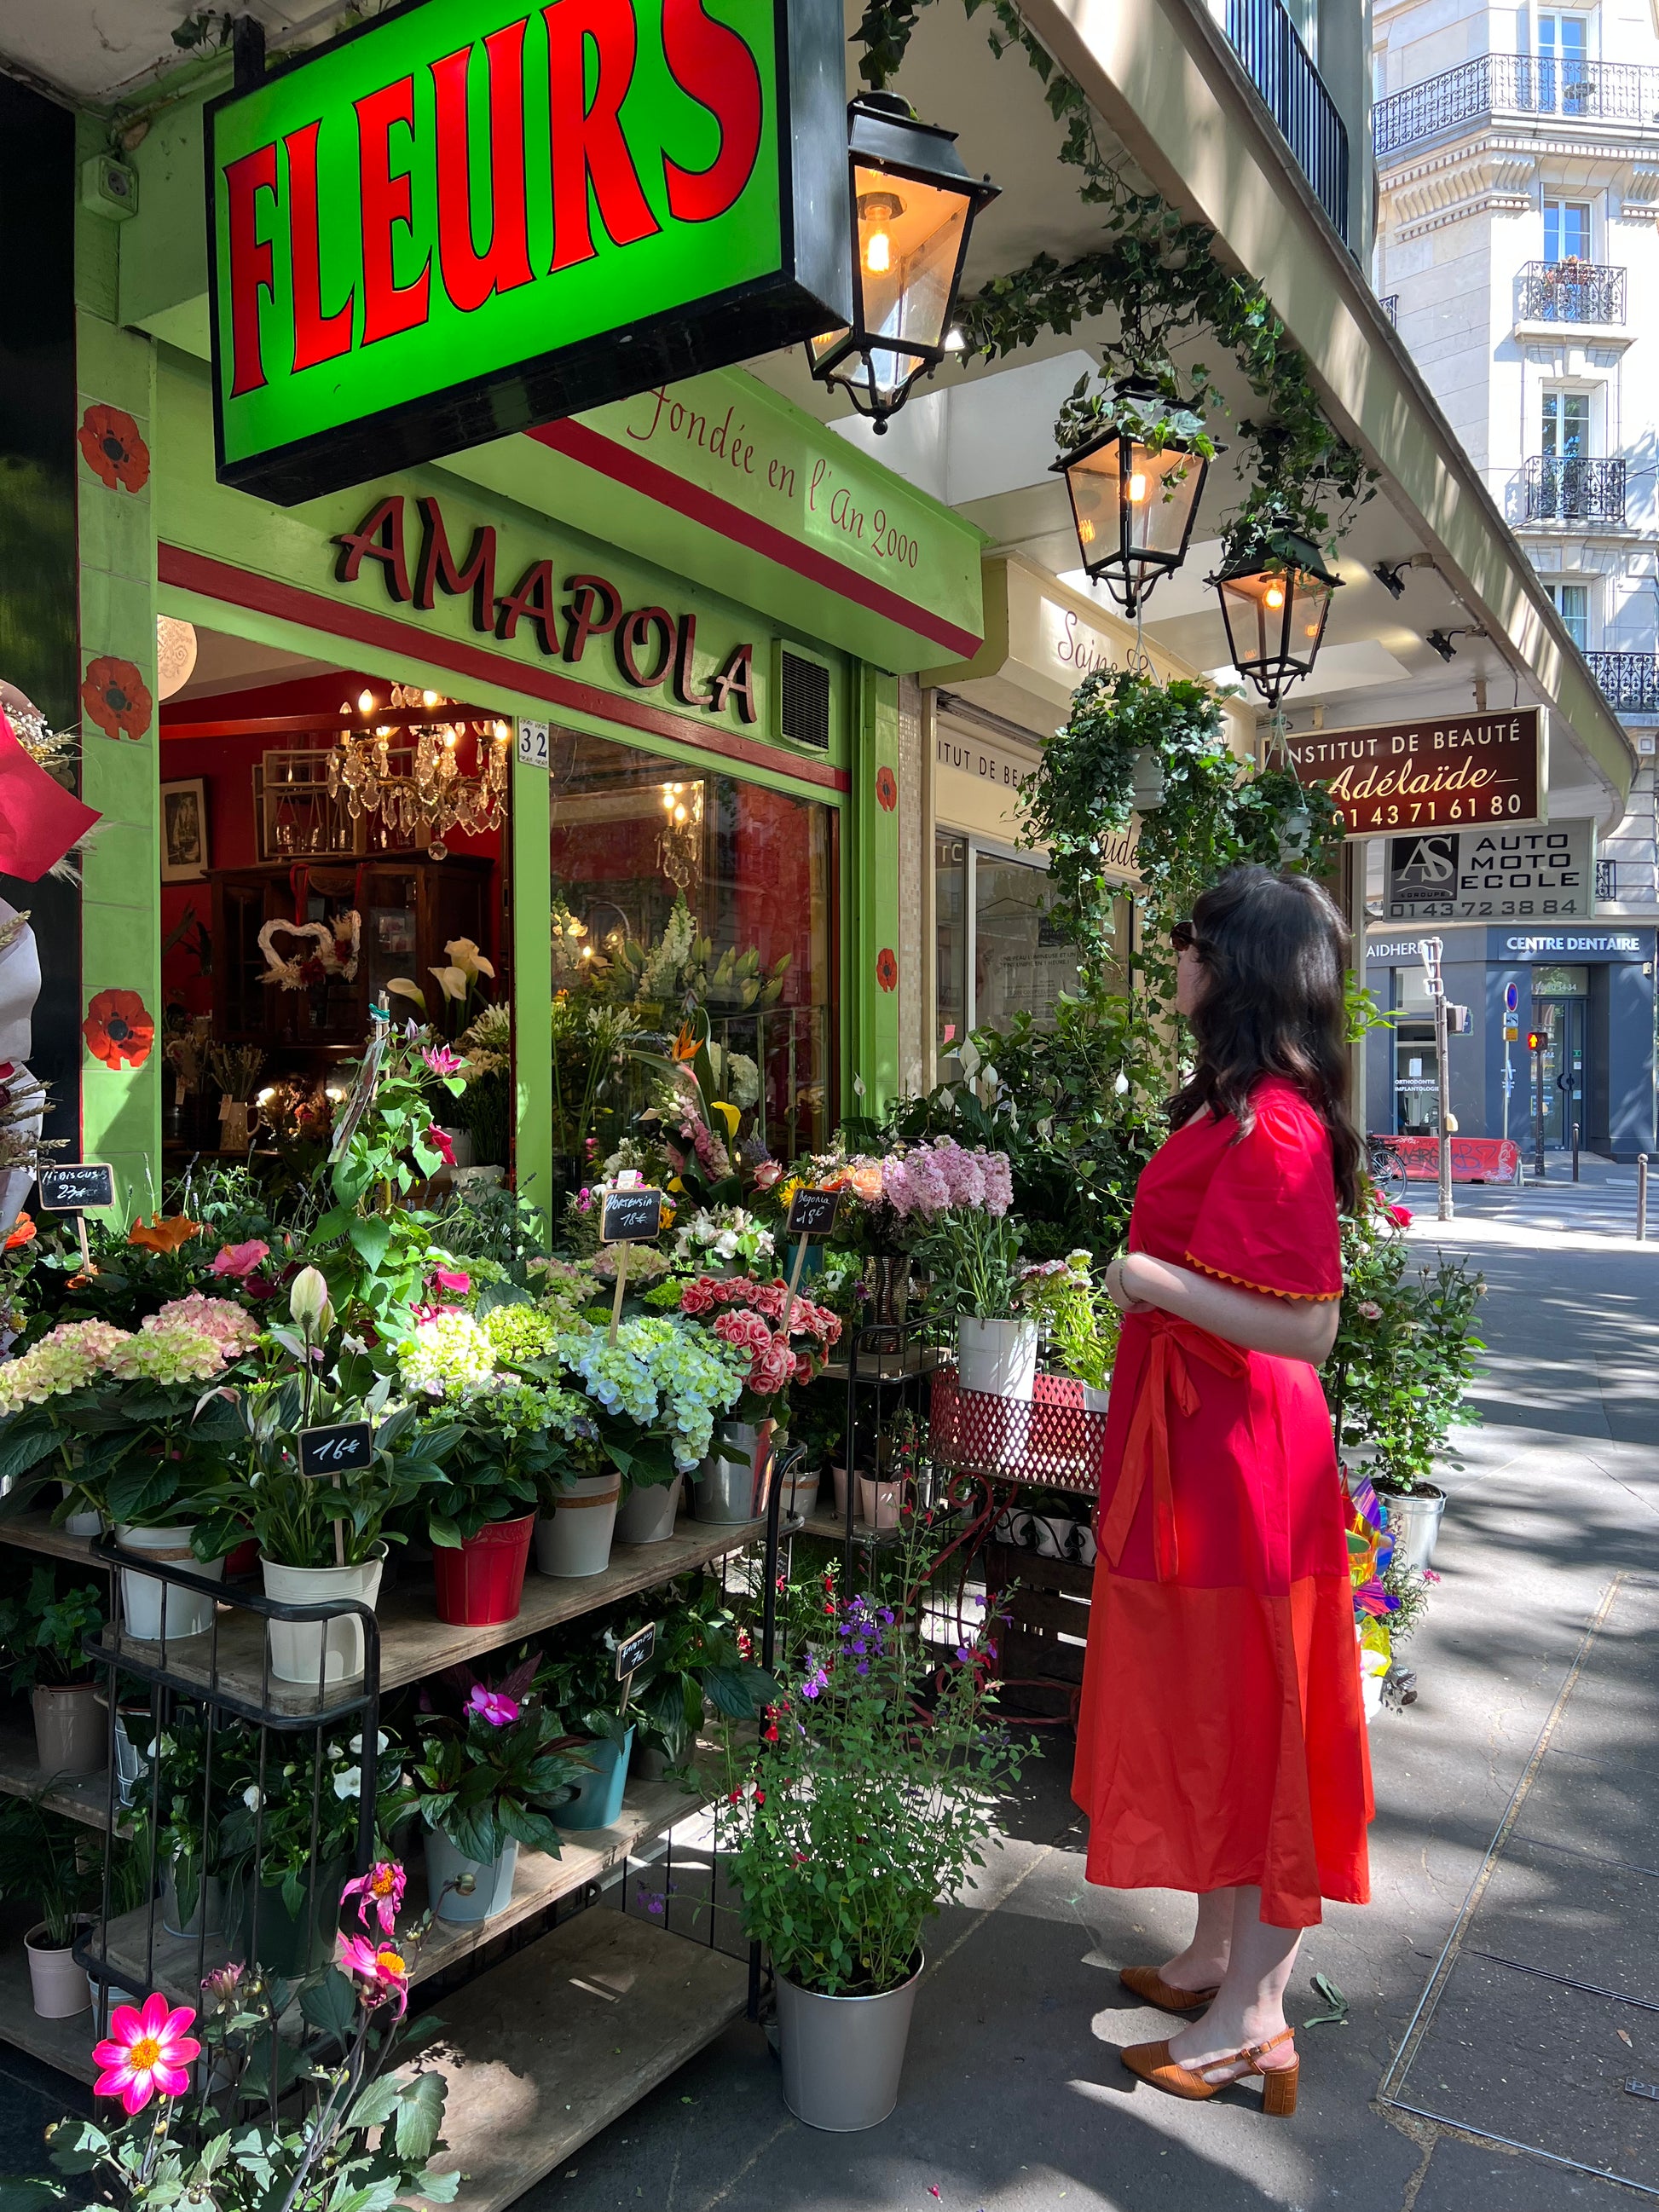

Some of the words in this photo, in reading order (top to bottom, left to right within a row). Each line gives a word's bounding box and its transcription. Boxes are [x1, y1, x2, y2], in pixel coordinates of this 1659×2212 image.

[223, 0, 763, 398] FLEURS
[627, 385, 755, 474] fondée
[768, 459, 795, 498] en
[870, 509, 918, 569] 2000
[330, 494, 758, 724] AMAPOLA
[521, 727, 547, 758] 32
[1280, 738, 1378, 766] INSTITUT
[1391, 734, 1419, 754] DE
[1434, 718, 1520, 749] BEAUTÉ
[980, 756, 995, 779] DE
[1327, 755, 1497, 802] Adélaïde
[1332, 809, 1357, 828] 01
[1371, 806, 1399, 825] 43
[1410, 801, 1436, 823] 71
[1450, 798, 1476, 819] 61
[1491, 794, 1521, 816] 80
[1476, 834, 1568, 852] AUTO
[1395, 836, 1454, 883] AS
[1471, 853, 1570, 870] MOTO
[1460, 872, 1580, 889] ECOLE
[1461, 902, 1493, 915] 72
[1501, 900, 1534, 915] 38
[1542, 898, 1577, 914] 84
[1506, 937, 1564, 950] CENTRE
[1567, 938, 1640, 950] DENTAIRE
[620, 1212, 647, 1227] 18€
[312, 1438, 361, 1460] 16€
